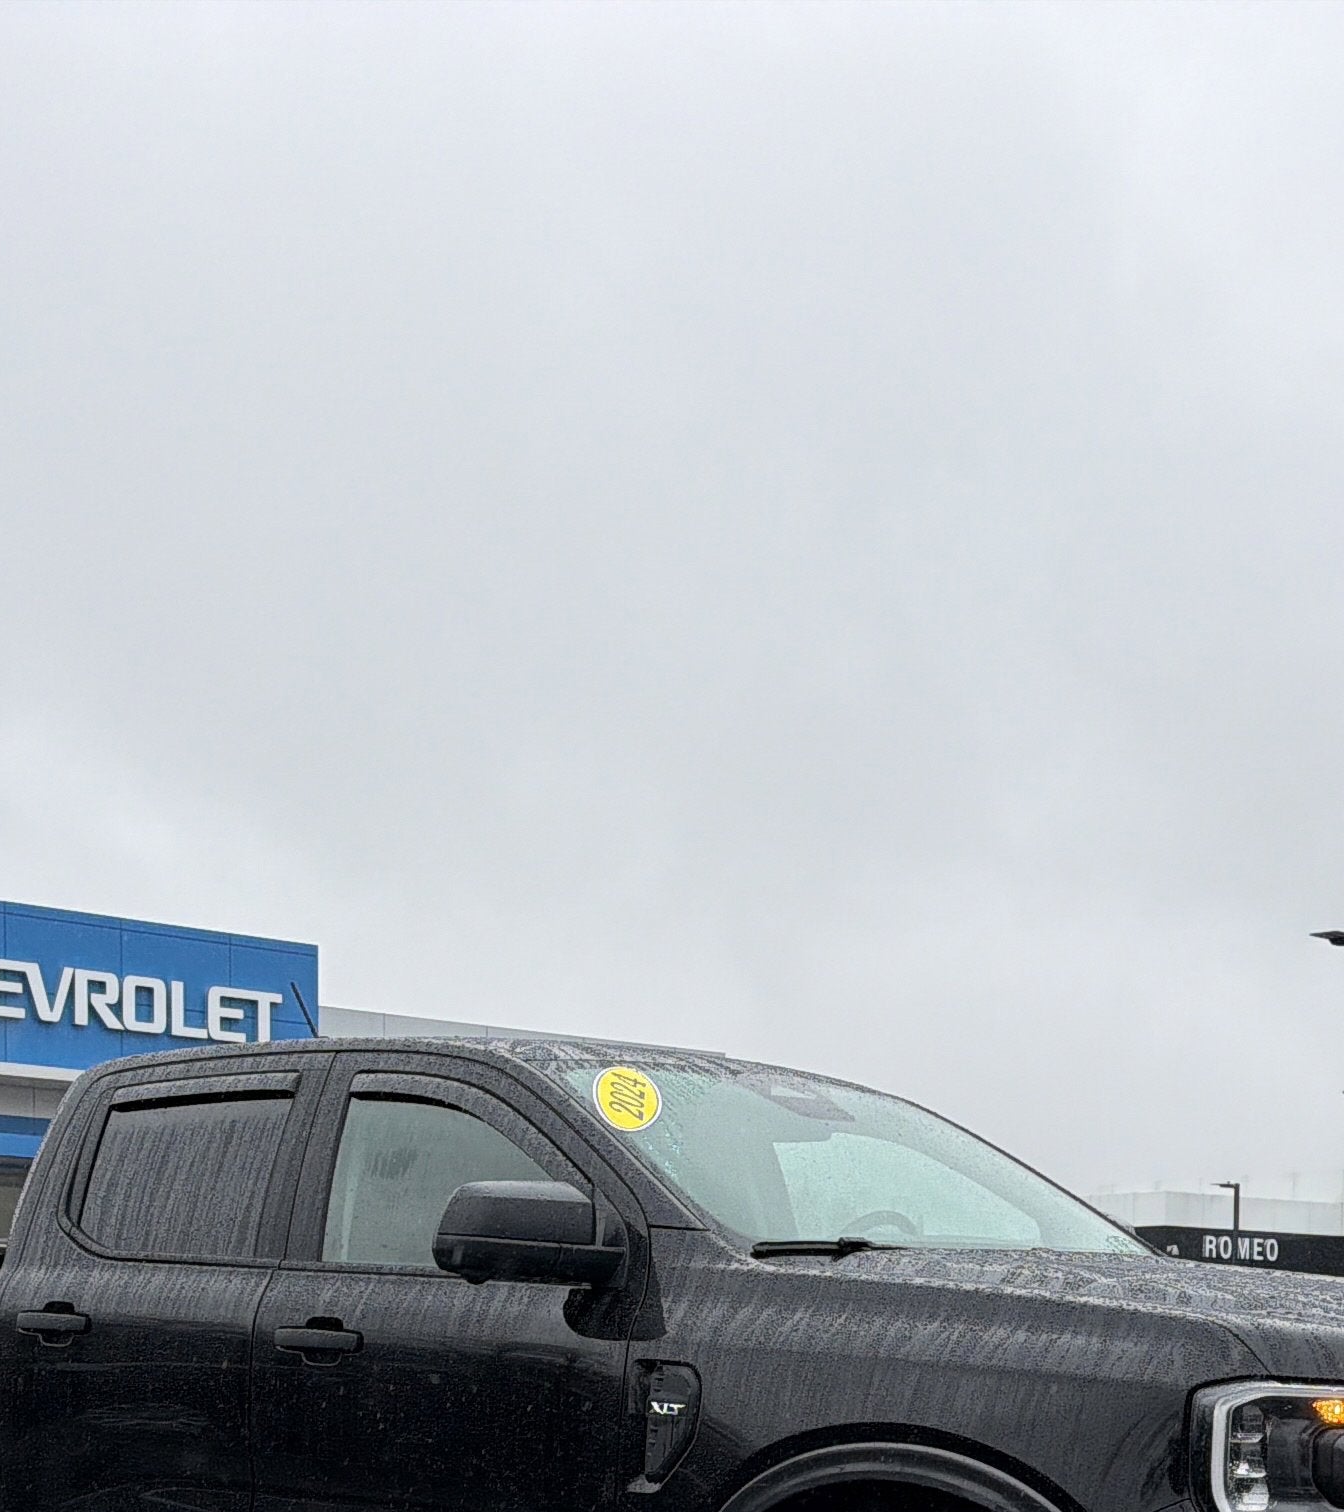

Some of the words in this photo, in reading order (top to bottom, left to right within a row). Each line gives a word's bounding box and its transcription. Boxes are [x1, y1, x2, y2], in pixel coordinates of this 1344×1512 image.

[609, 1072, 646, 1121] 2024
[1202, 1235, 1279, 1262] ROMEO
[649, 1401, 687, 1415] XLT
